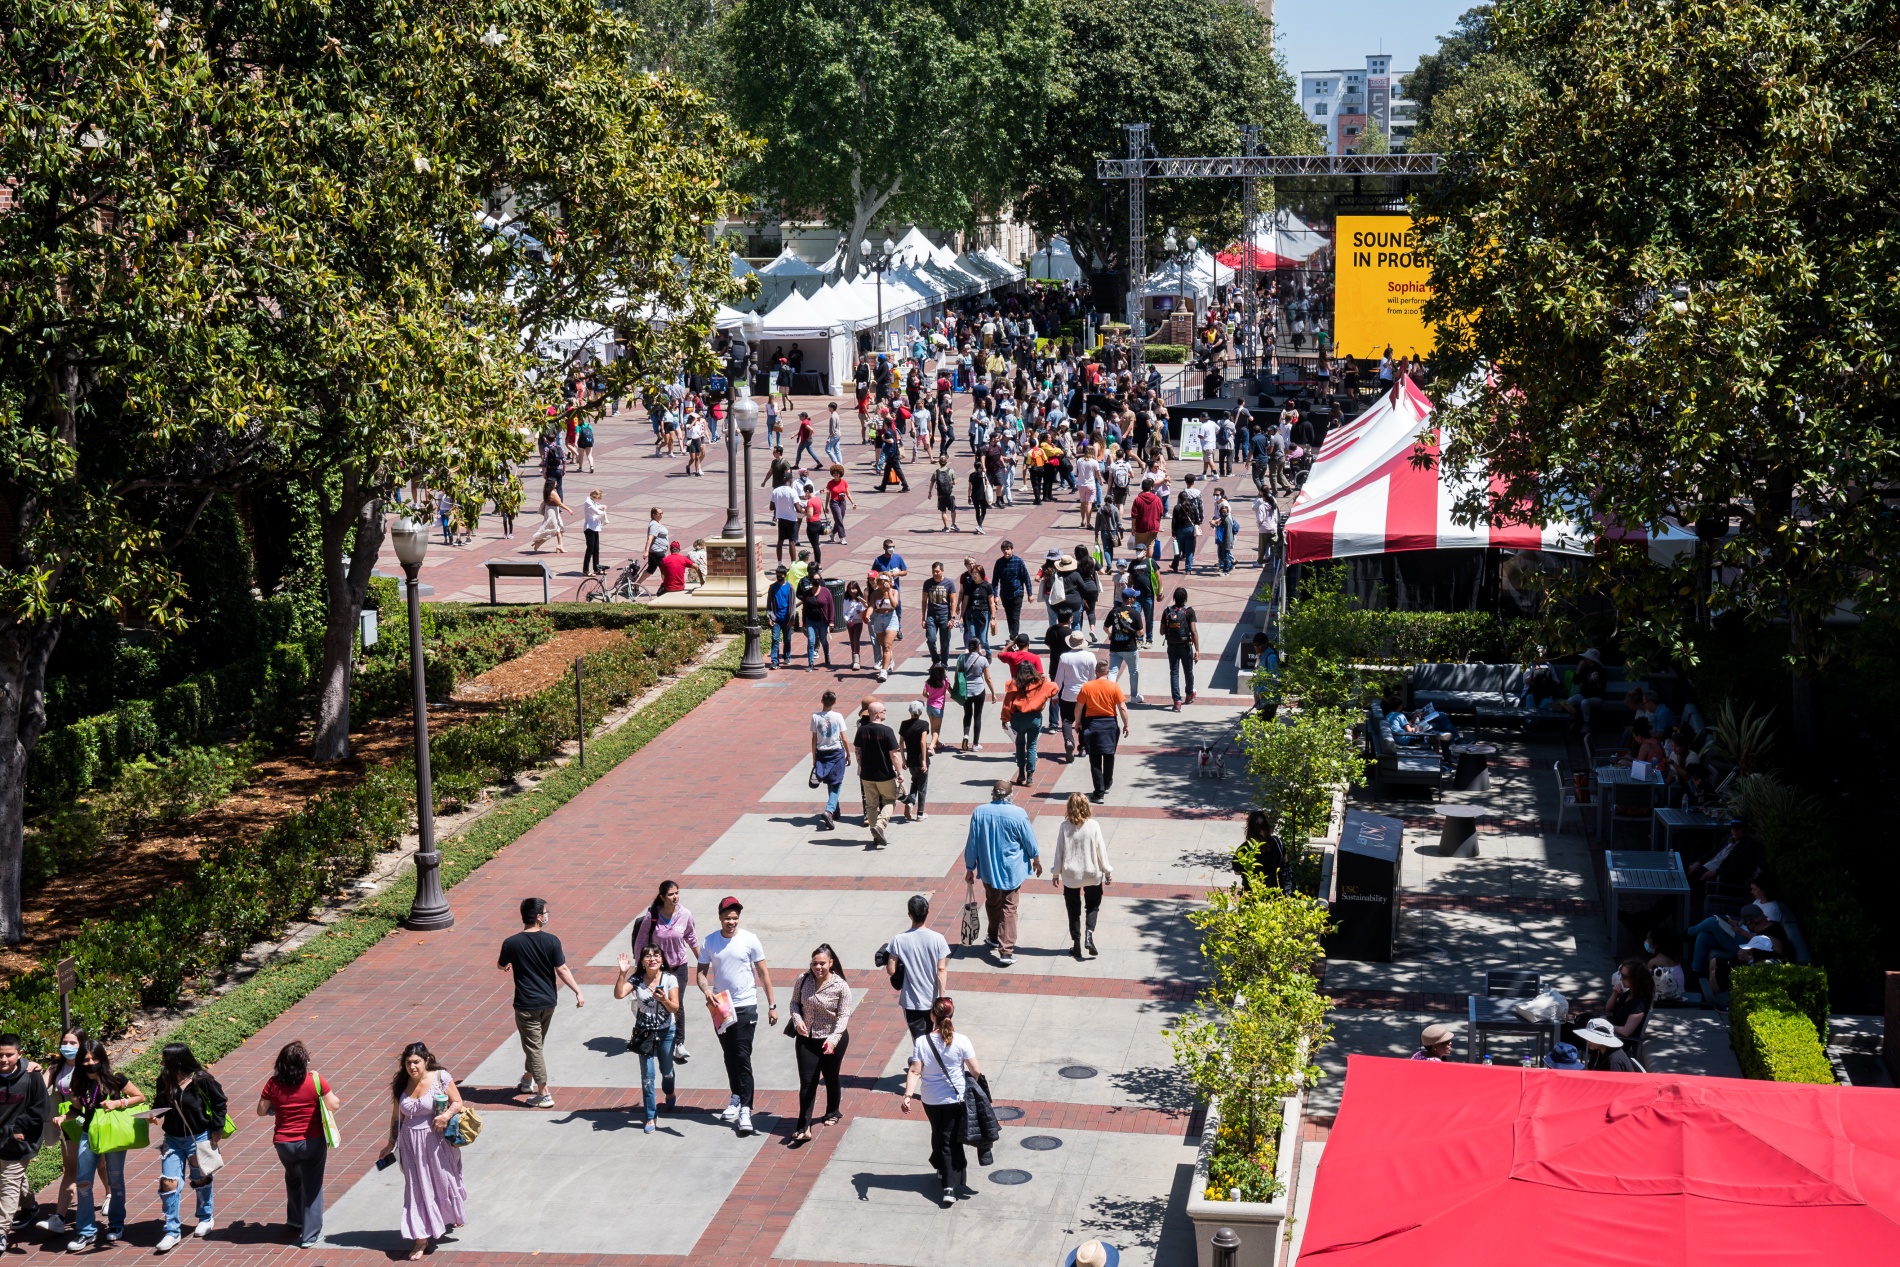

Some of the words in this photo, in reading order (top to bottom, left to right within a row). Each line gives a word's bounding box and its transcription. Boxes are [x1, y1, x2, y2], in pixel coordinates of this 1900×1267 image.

[1373, 93, 1384, 128] LIVE
[1353, 252, 1371, 267] IN
[1388, 281, 1426, 295] Sophia
[1387, 296, 1399, 304] will
[1387, 307, 1402, 315] from
[1341, 885, 1359, 893] USC
[1342, 892, 1388, 904] Sustainability
